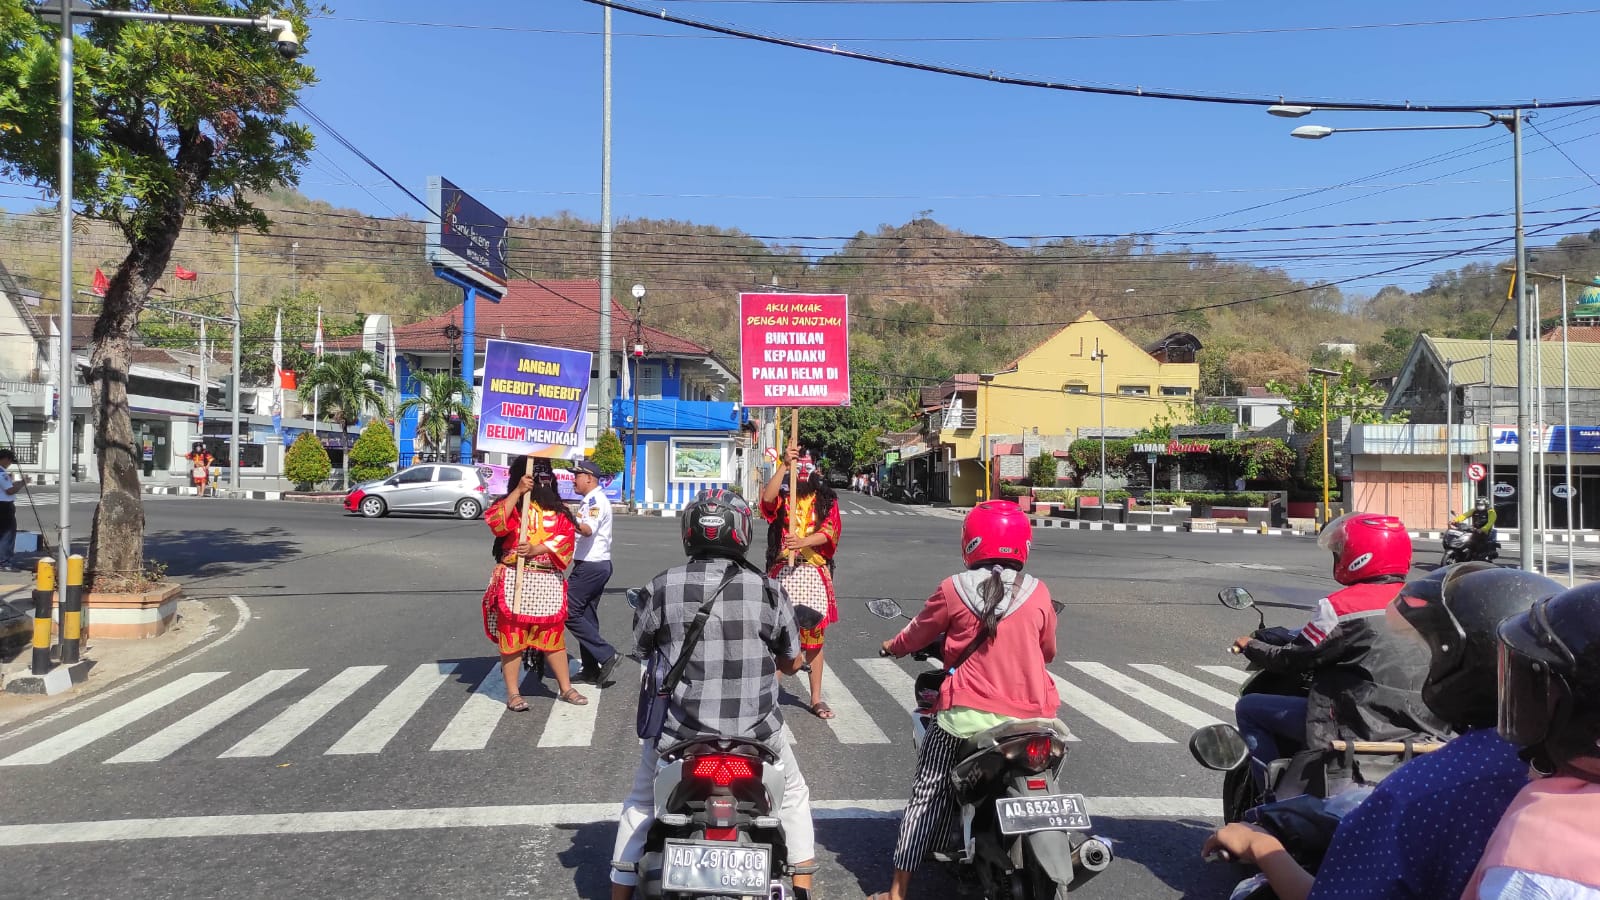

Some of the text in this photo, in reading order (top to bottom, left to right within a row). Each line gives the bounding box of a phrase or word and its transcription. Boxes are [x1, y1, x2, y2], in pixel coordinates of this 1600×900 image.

[765, 303, 823, 313] AKU MUAK
[746, 315, 842, 327] DENGAN JANJIMU
[765, 332, 824, 345] BUKTIKAN
[764, 349, 826, 362] KEPADAKU
[517, 358, 561, 377] JANGAN
[752, 367, 839, 380] PAKAI HELM DI
[490, 378, 582, 401] NGEBUT-NGEBUT
[764, 384, 828, 397] KEPALAMU
[501, 402, 568, 423] INGAT ANDA
[486, 424, 579, 446] BELUM MENIKAH
[1132, 443, 1166, 453] TAMAN
[1005, 802, 1022, 818] AD
[673, 848, 693, 867] AD
